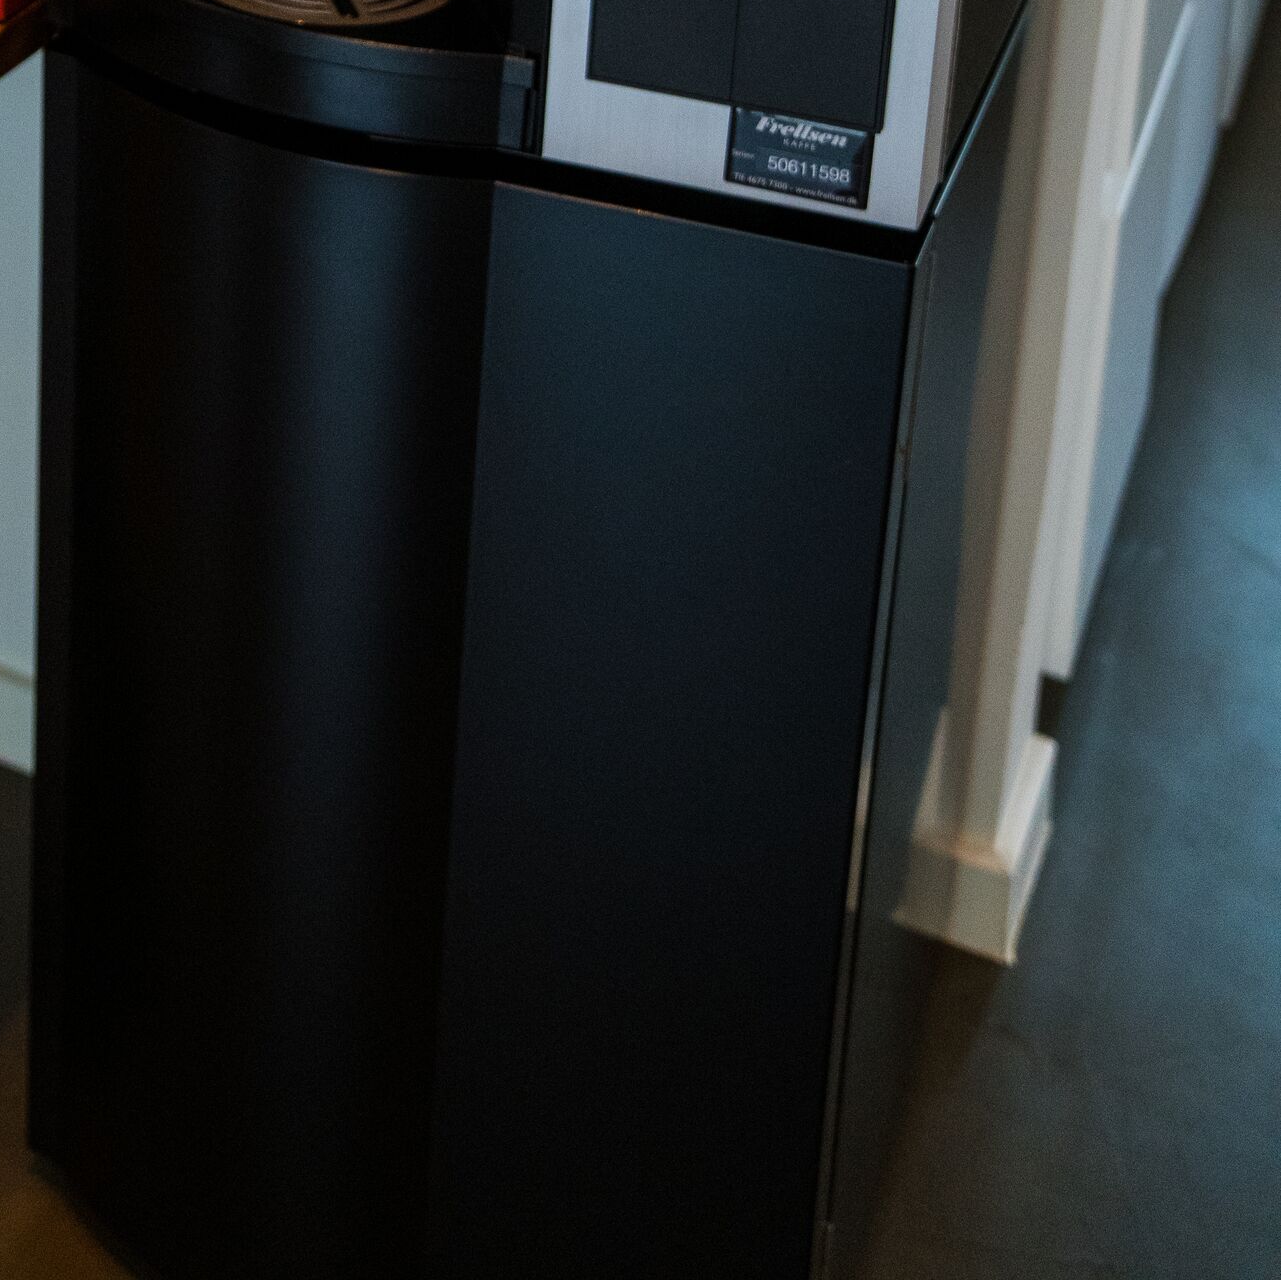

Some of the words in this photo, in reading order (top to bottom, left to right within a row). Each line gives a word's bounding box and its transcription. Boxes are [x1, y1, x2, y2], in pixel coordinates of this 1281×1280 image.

[756, 115, 848, 149] Frellsen
[783, 138, 817, 151] KAFFE
[767, 155, 851, 184] 50611598
